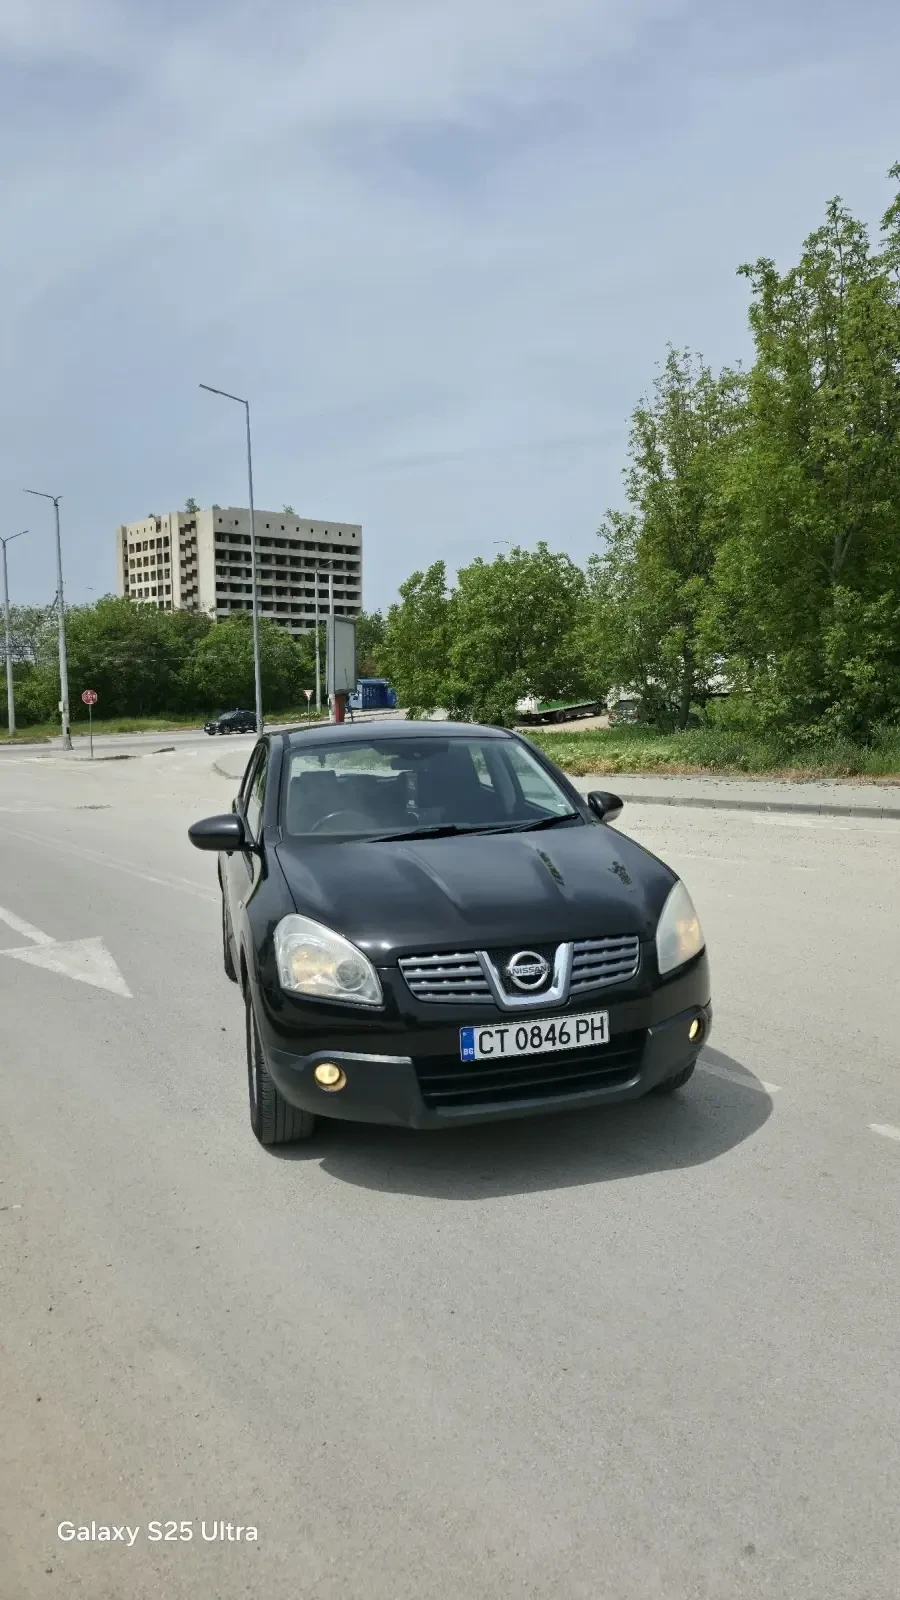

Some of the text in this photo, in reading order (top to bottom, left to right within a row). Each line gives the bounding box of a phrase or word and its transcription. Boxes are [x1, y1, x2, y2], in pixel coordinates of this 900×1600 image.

[512, 965, 548, 975] NISSAN
[478, 1016, 605, 1054] CT 0846 PH
[463, 1048, 474, 1056] BG
